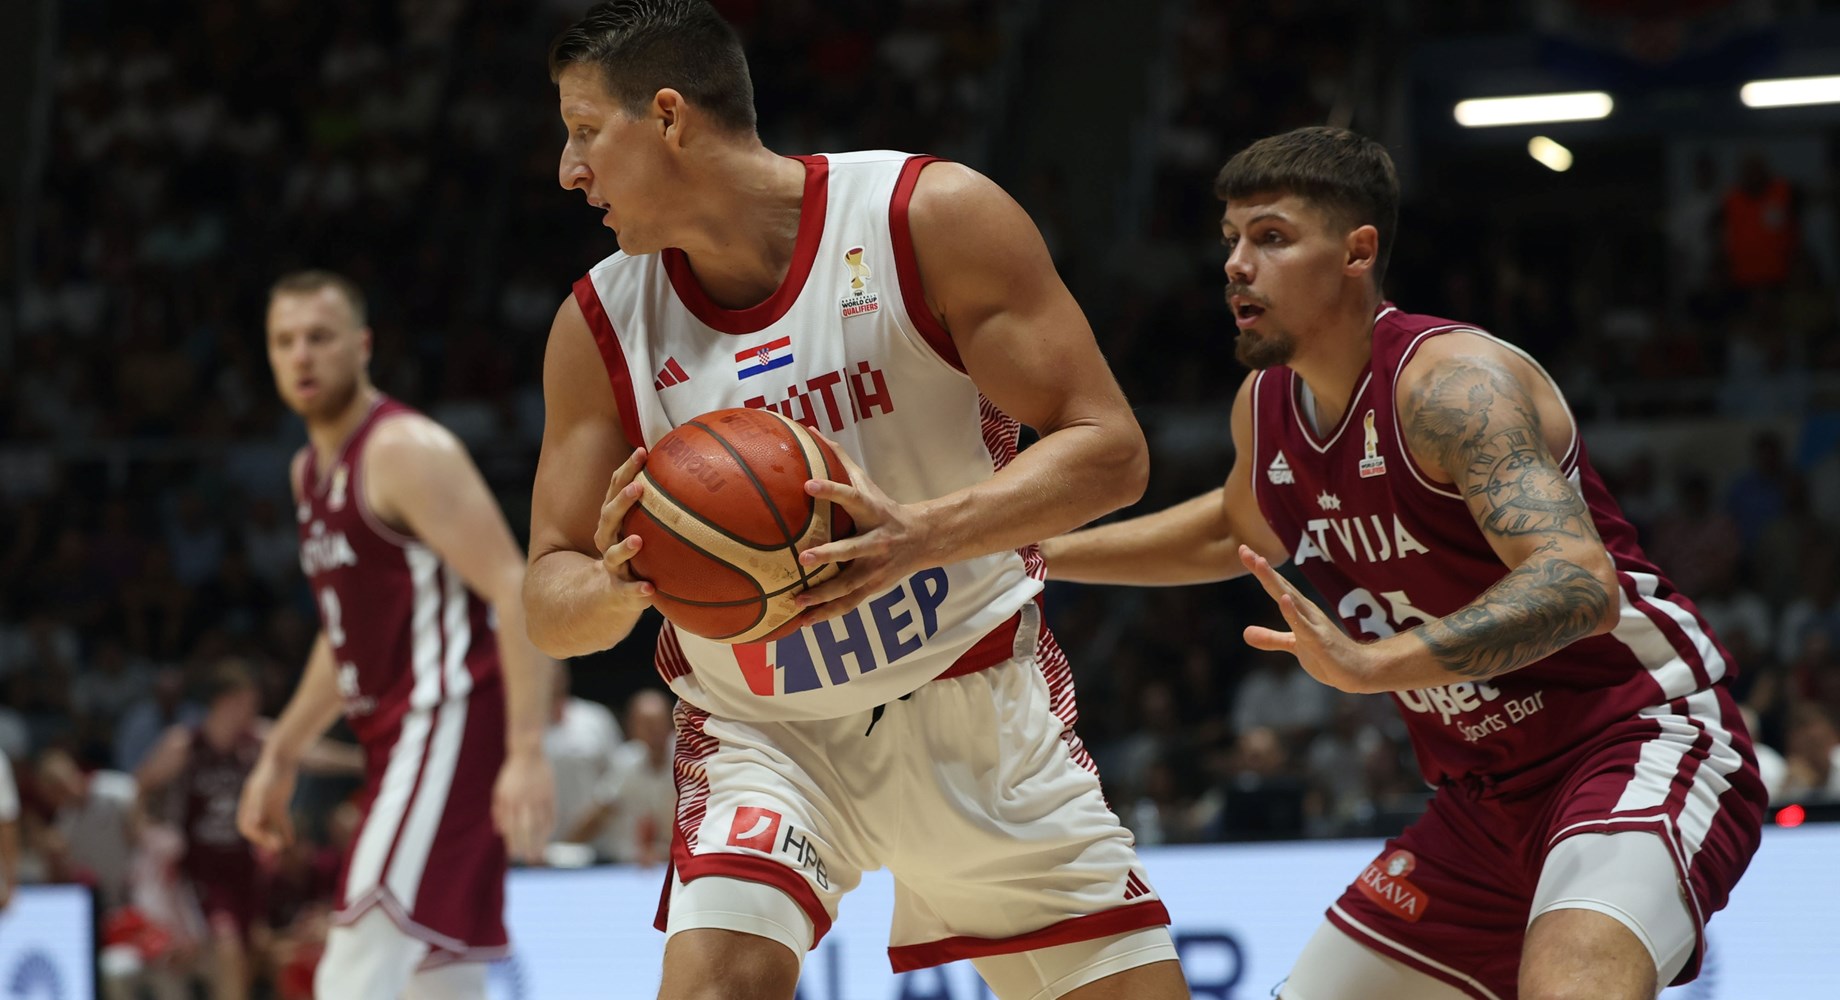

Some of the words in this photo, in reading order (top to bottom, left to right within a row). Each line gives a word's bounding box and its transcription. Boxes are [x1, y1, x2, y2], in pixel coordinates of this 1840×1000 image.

[842, 300, 864, 308] WORLD
[842, 303, 878, 316] QUALIFIERS
[1294, 513, 1430, 566] ATVIJA
[811, 566, 949, 686] HEP
[1457, 713, 1507, 744] Sports
[1504, 690, 1544, 724] Bar
[782, 825, 829, 890] HPB
